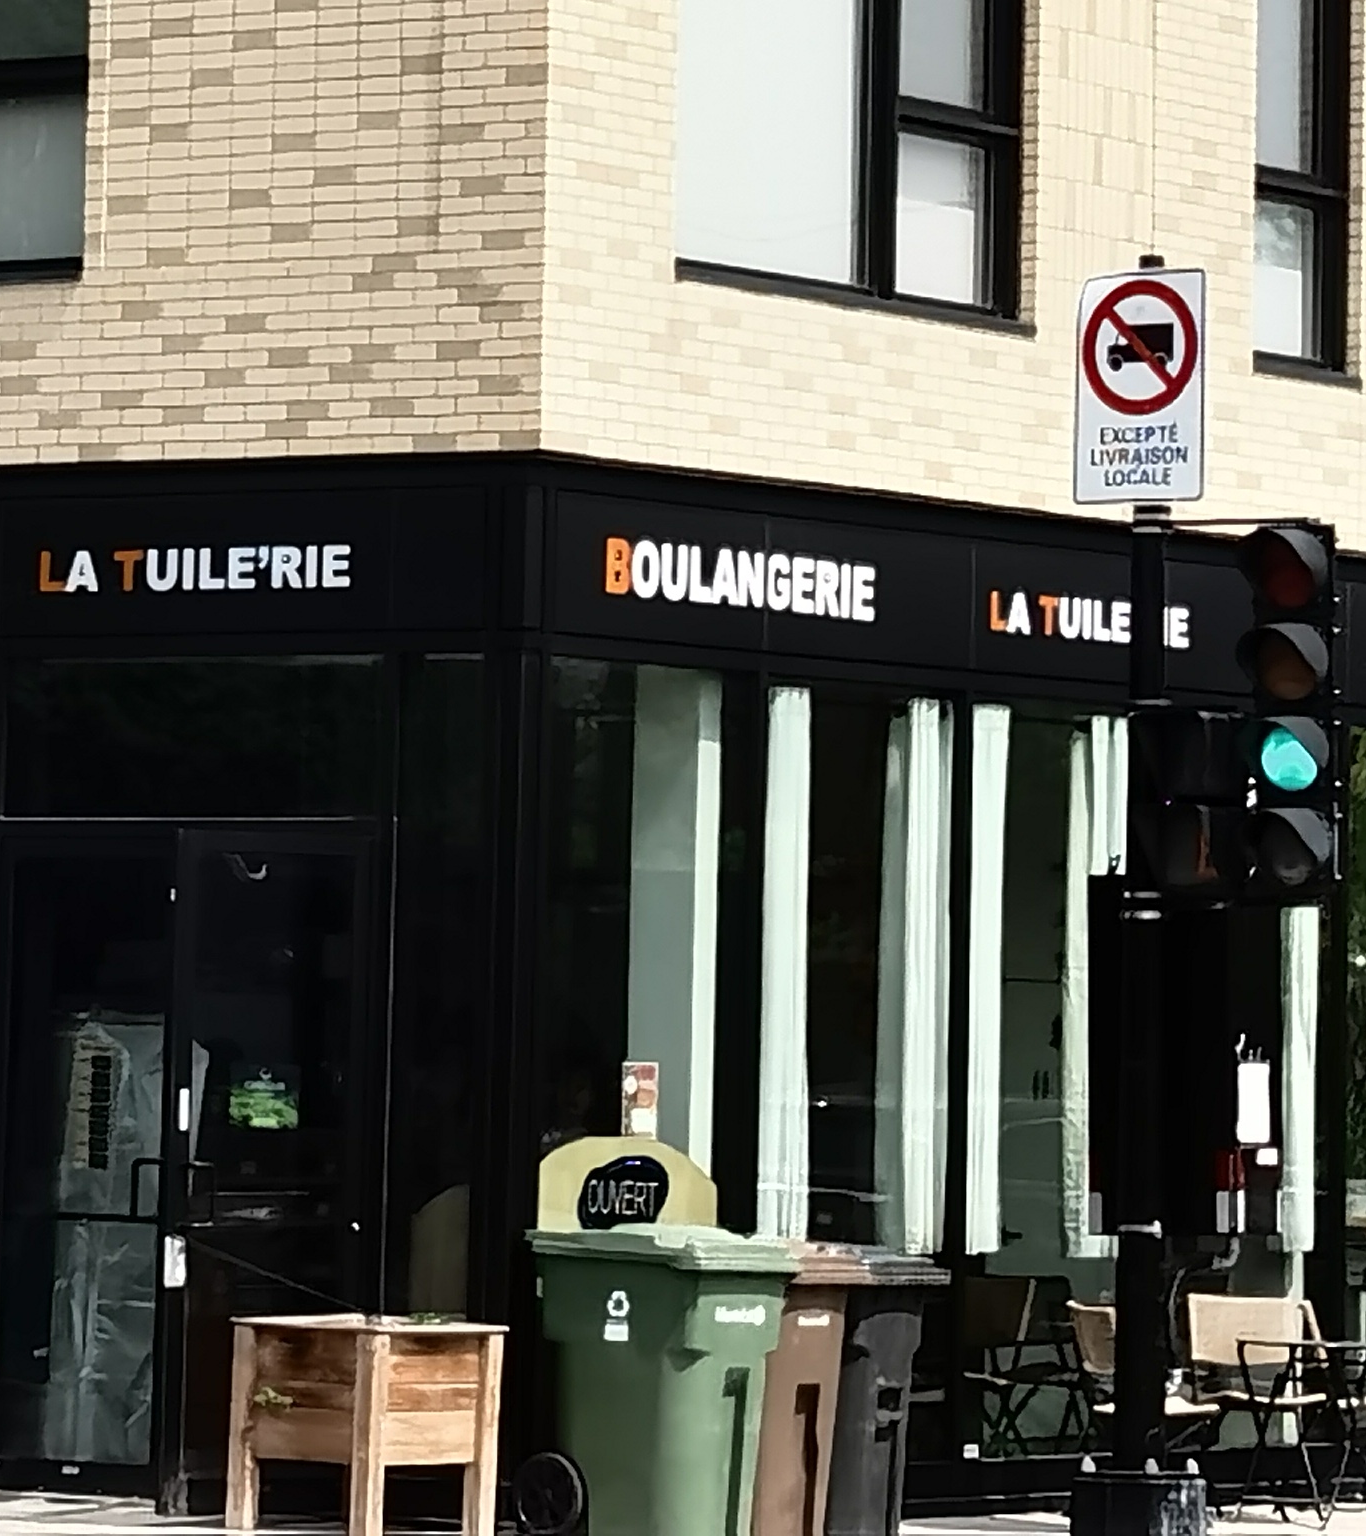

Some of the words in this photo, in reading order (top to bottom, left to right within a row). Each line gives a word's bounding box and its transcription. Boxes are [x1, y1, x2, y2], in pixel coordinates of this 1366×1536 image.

[1100, 419, 1178, 445] EXCEPTÉ
[1090, 446, 1188, 467] LIVRAISON
[1104, 467, 1172, 487] LOCALE
[39, 550, 99, 592] LA
[604, 537, 876, 622] BOULANGERIE
[990, 590, 1031, 635] LA
[588, 1179, 659, 1217] OUVERT
